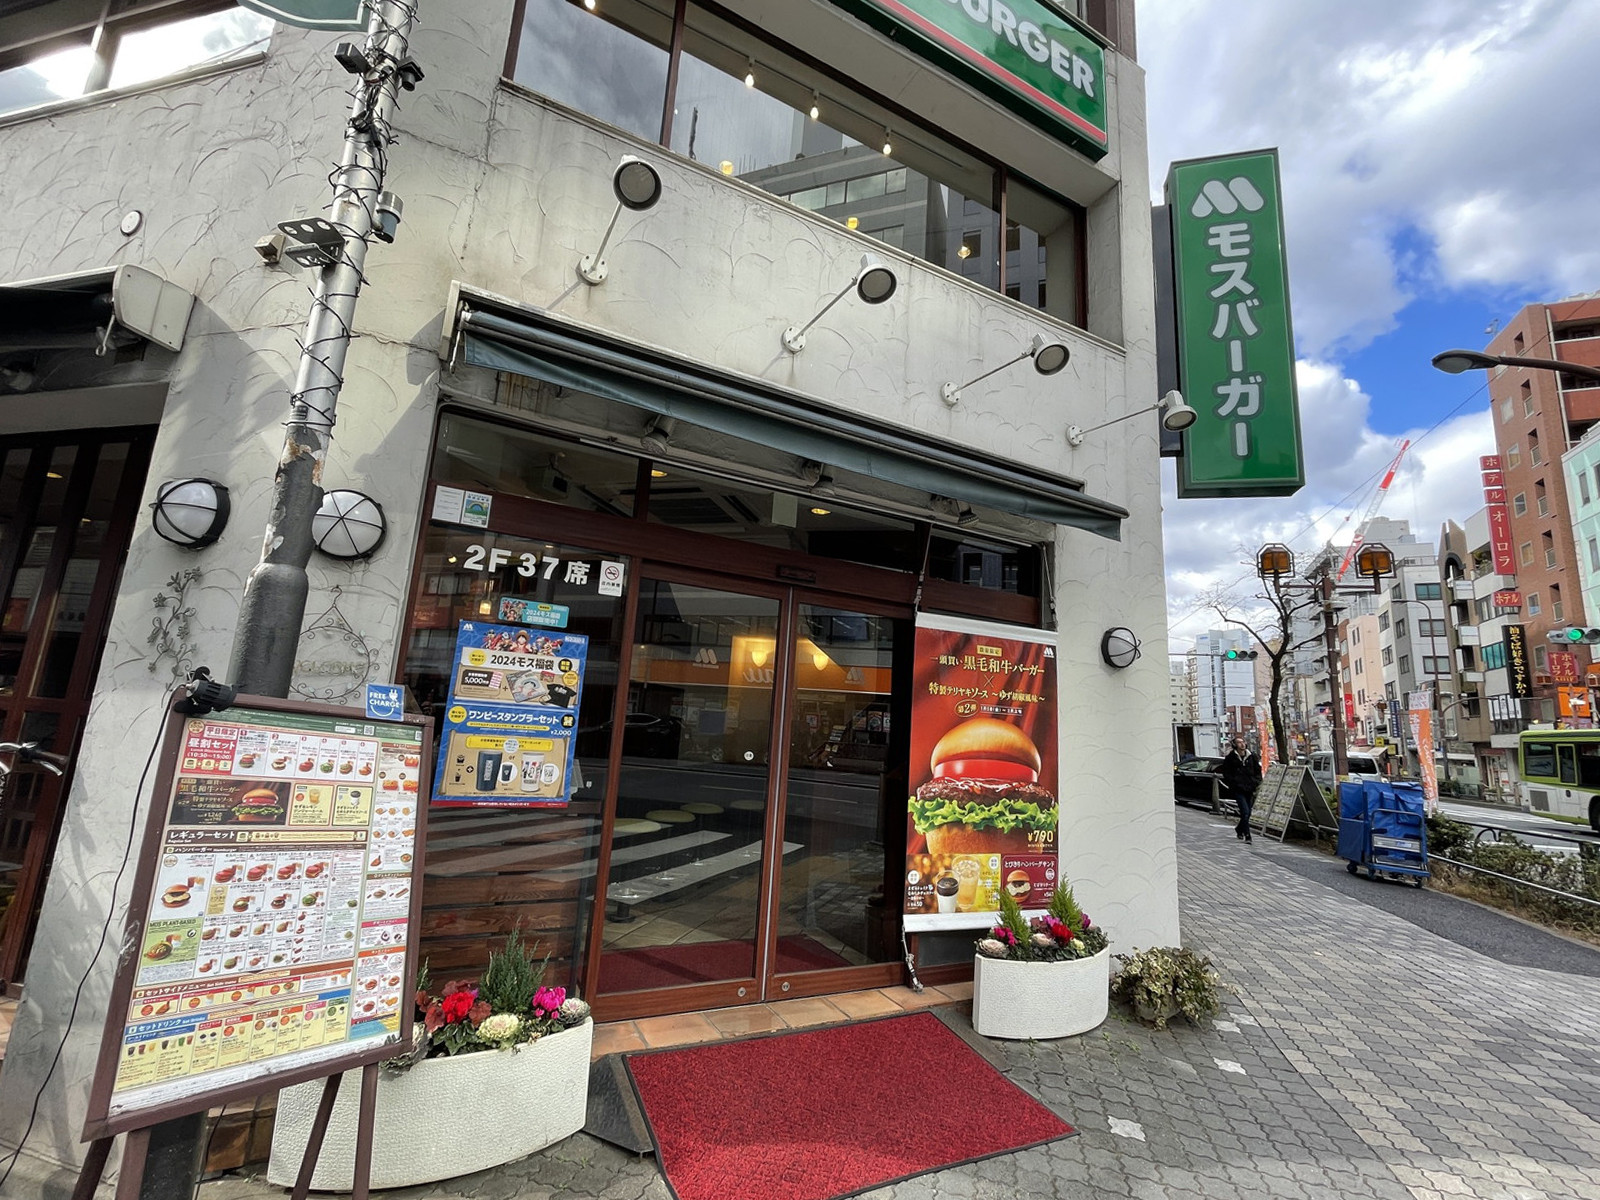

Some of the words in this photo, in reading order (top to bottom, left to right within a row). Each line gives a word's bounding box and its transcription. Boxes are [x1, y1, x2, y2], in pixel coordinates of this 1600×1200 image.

[947, 0, 1094, 98] URGER
[1207, 223, 1262, 456] モスバーガー
[1486, 457, 1501, 499] ホテル
[1493, 511, 1511, 567] オーロラ
[463, 544, 512, 573] 2F
[1495, 593, 1519, 603] ホテル
[490, 654, 554, 671] 2024モス福袋
[1550, 653, 1561, 676] オーロラ
[1561, 653, 1574, 676] ホテル
[369, 691, 387, 700] FREE
[369, 699, 400, 708] CHARGE
[468, 710, 560, 725] ワンピースタンブラーセット
[170, 830, 235, 839] レギュラーセット
[1027, 830, 1054, 842] ¥790
[138, 1019, 181, 1032] セットドリンク
